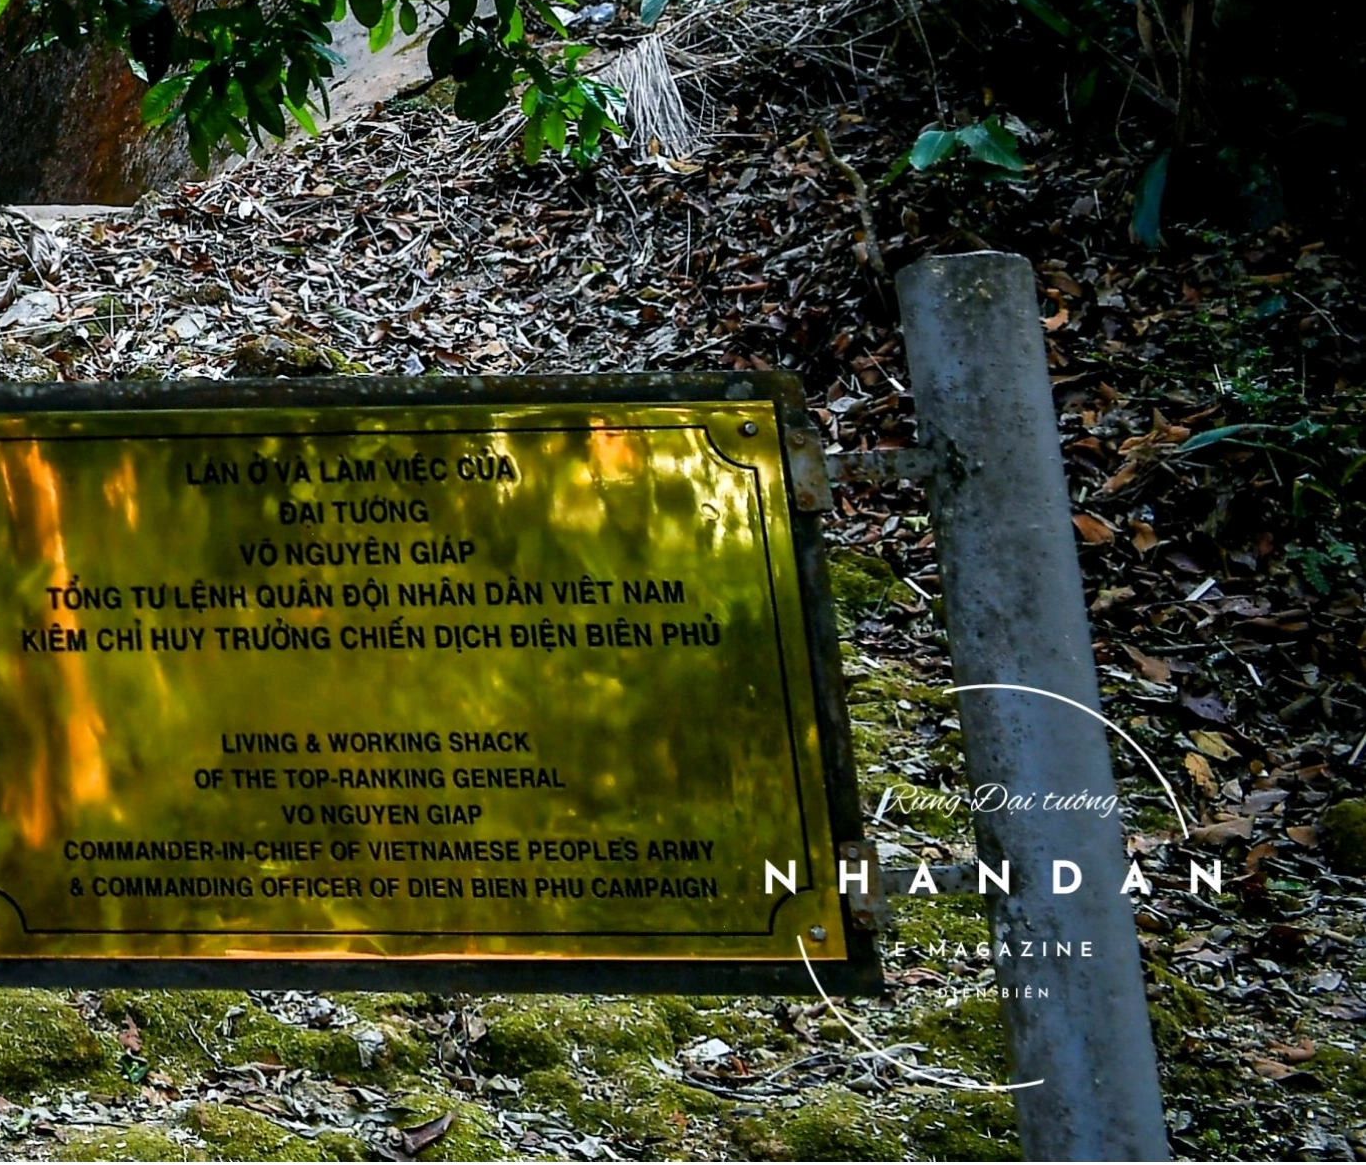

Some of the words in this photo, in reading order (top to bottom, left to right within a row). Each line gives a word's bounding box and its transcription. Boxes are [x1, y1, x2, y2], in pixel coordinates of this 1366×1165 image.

[248, 450, 268, 485] Ở
[275, 452, 312, 484] VÀ
[320, 454, 376, 483] LÀM
[385, 452, 448, 485] VIỆC
[457, 446, 515, 482] CỦA
[332, 497, 429, 524] TƯỚNG
[240, 538, 278, 567] VÕ
[286, 536, 402, 567] NGUYÊN
[410, 536, 475, 565] GIÁP
[46, 574, 122, 610] TỔNG
[130, 583, 167, 609] TƯ
[174, 579, 247, 613] LỆNH
[256, 578, 334, 608] QUÂN
[342, 578, 389, 612] ĐỘI
[399, 577, 476, 606] NHÂN
[485, 576, 543, 606] DÂN
[623, 580, 685, 604] NAM
[22, 623, 87, 652] KIÊM
[97, 618, 143, 651] CHỈ
[151, 627, 205, 651] HUY
[215, 617, 331, 650] TRƯỞNG
[339, 616, 426, 650] CHIẾN
[434, 624, 502, 653] DỊCH
[511, 618, 577, 652] ĐIỆN
[586, 618, 653, 648] BIÊN
[662, 613, 722, 647] PHỦ
[221, 733, 297, 754] LIVING
[306, 733, 322, 753] &
[328, 732, 441, 753] WORKING
[448, 732, 531, 753] SHACK
[194, 769, 225, 790] OF
[234, 769, 277, 789] THE
[287, 768, 445, 789] TOP-RANKING
[453, 768, 566, 789] GENERAL
[282, 805, 314, 825] VO
[321, 805, 419, 825] NGUYEN
[426, 804, 483, 825] GIAP
[64, 841, 323, 862] COMMANDER-IN-CHIEF
[330, 841, 363, 862] OF
[368, 840, 520, 861] VIETNAMESE
[647, 840, 714, 861] ARMY
[70, 878, 85, 898] &
[92, 877, 253, 898] COMMANDING
[261, 877, 363, 898] OFFICER
[369, 877, 400, 898] OF
[408, 877, 464, 898] DIEN
[471, 877, 527, 898] BIEN
[534, 877, 585, 898] PHU
[592, 877, 718, 898] CAMPAIGN
